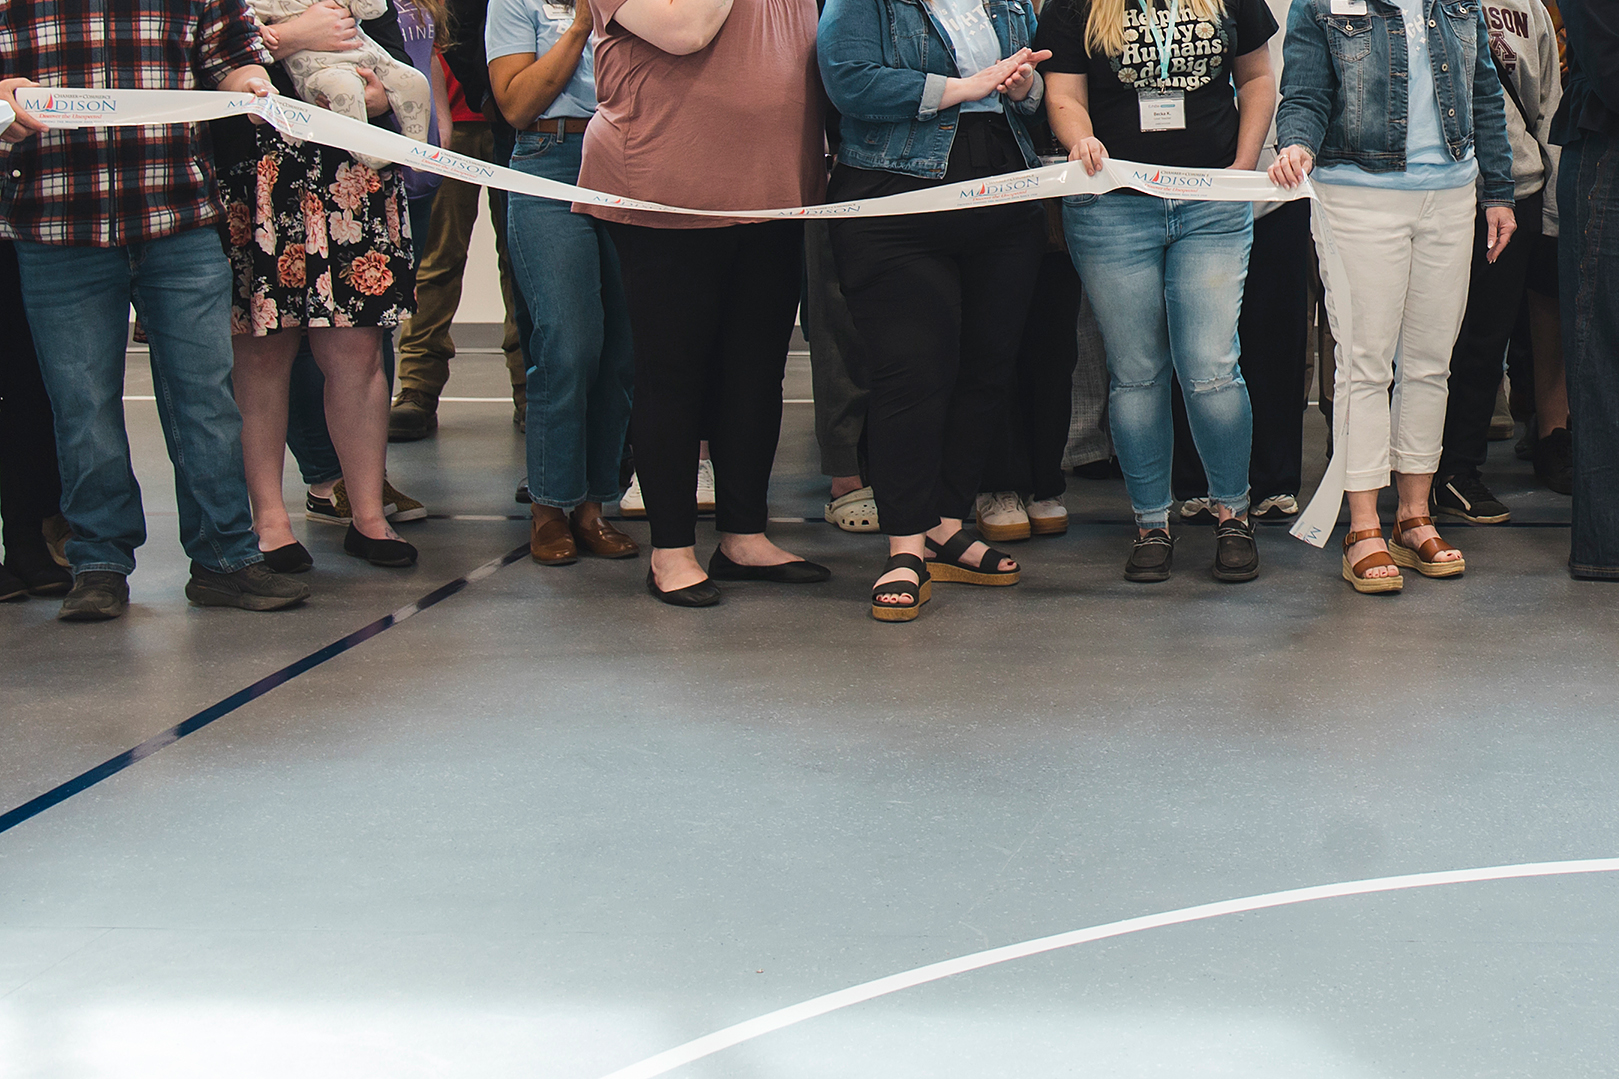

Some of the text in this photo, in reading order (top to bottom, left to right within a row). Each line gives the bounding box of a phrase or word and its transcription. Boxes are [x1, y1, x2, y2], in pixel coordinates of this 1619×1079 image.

[1482, 6, 1529, 38] ISON
[1170, 57, 1208, 76] Big
[25, 94, 116, 112] MADISON
[410, 147, 495, 178] MADISON
[960, 176, 1039, 199] MADISON
[1132, 169, 1213, 188] MADISON
